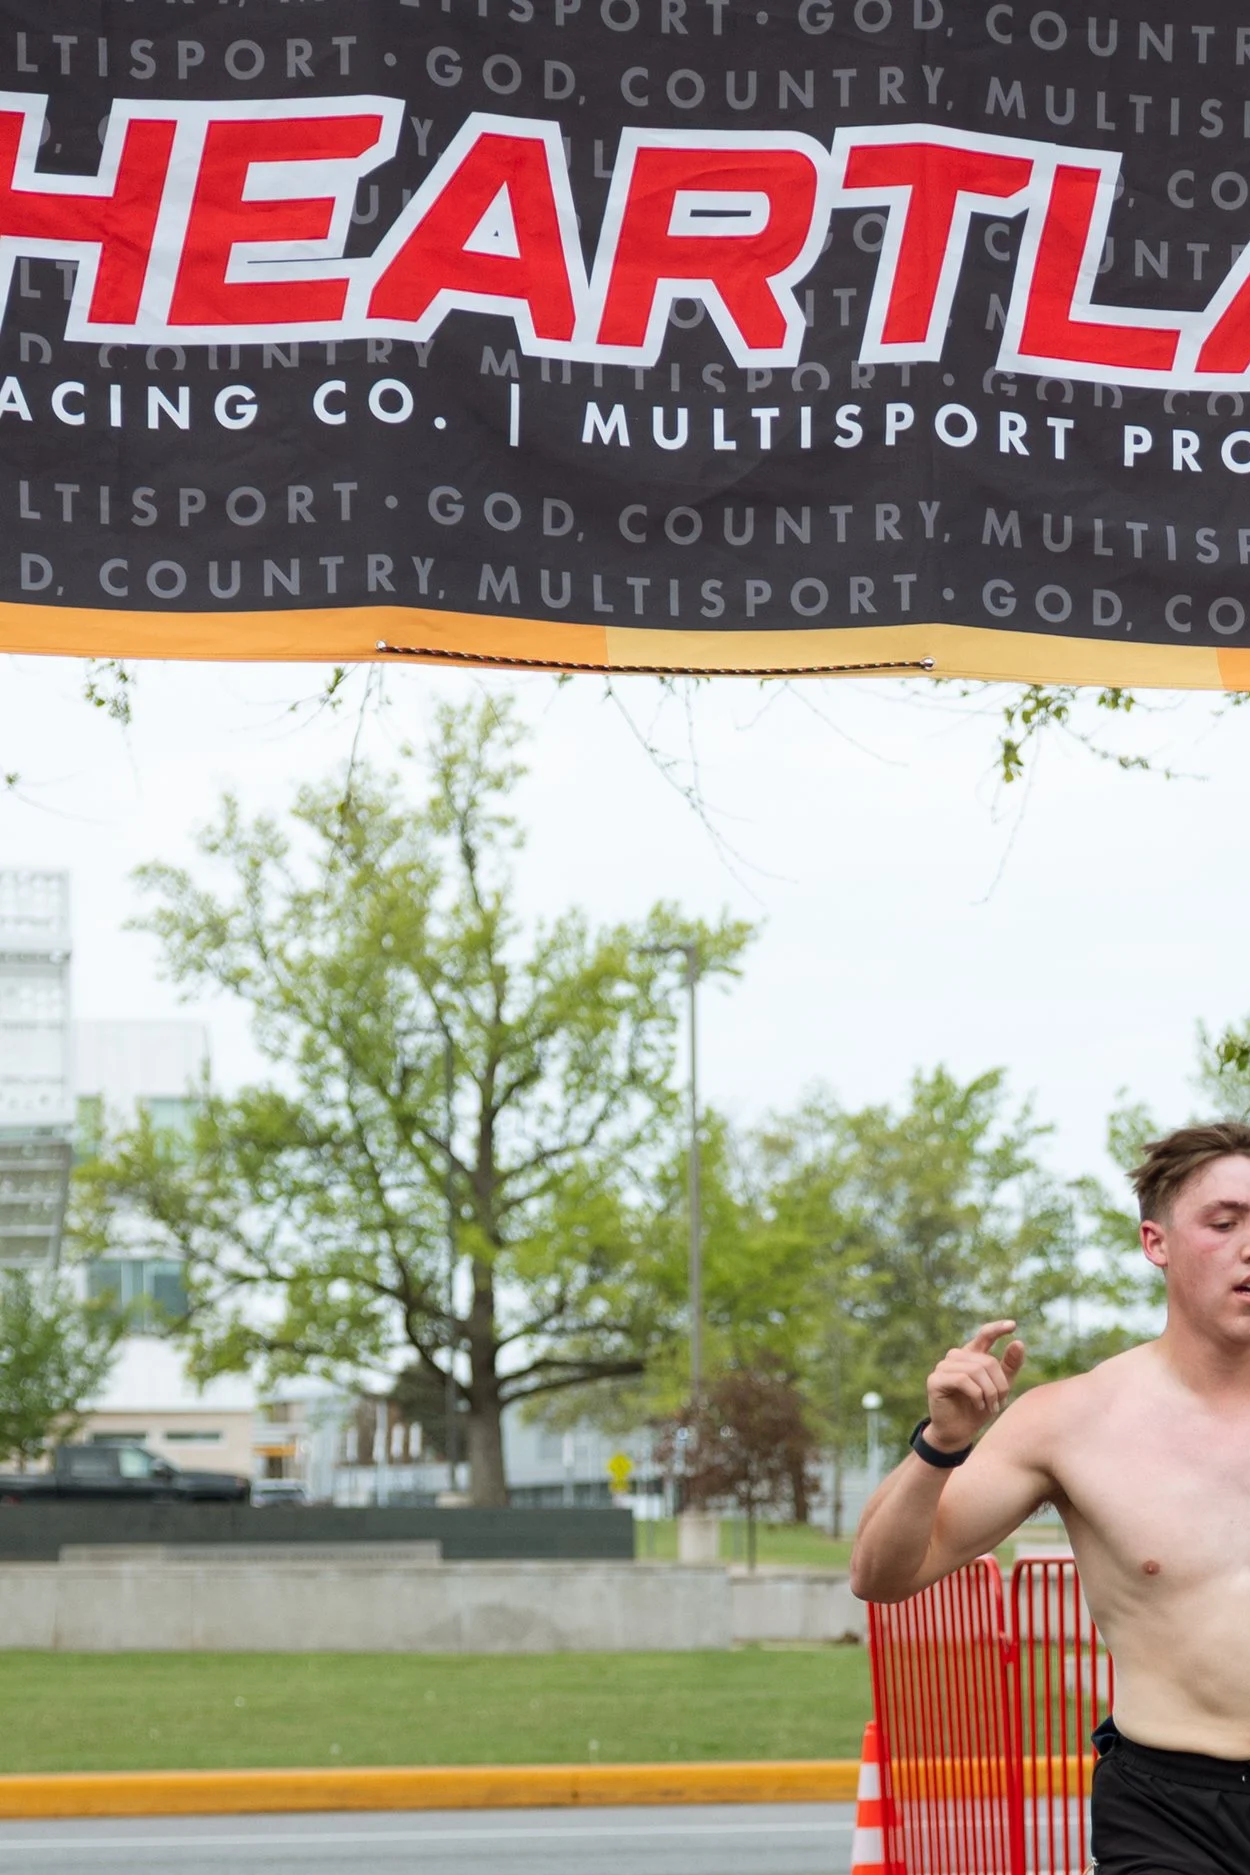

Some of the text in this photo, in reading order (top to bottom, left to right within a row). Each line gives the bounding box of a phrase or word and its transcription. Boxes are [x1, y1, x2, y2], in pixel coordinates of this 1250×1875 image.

[798, 0, 953, 38] GOD,
[16, 31, 357, 80] LTISPORT
[426, 46, 586, 106] GOD,
[620, 64, 955, 111] COUNTRY,
[0, 376, 258, 430] ACING
[313, 378, 447, 430] CO.
[582, 402, 1074, 460] MULTISPORT
[19, 480, 358, 527] LTISPORT
[427, 485, 585, 543] GOD,
[618, 500, 951, 546] COUNTRY,
[99, 553, 445, 599] COUNTRY,
[478, 563, 918, 618] MULTISPORT
[982, 578, 1133, 632] GOD,
